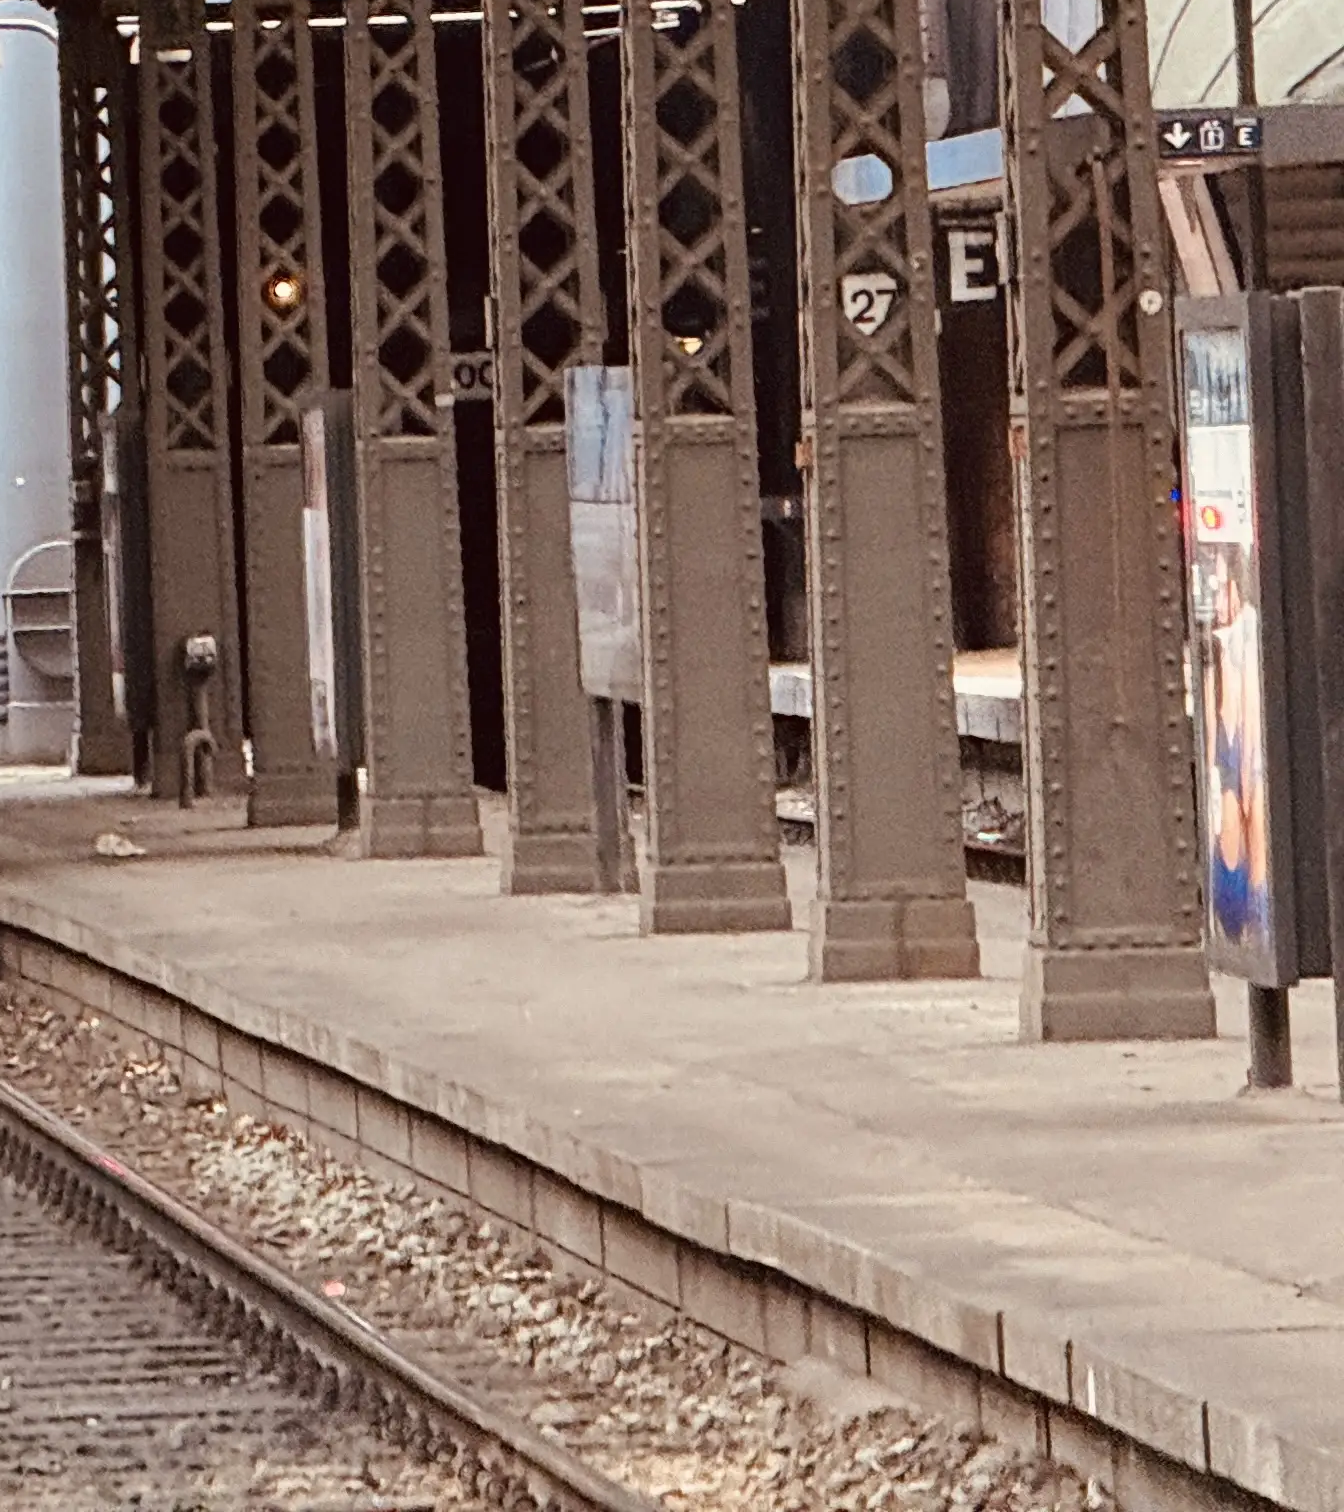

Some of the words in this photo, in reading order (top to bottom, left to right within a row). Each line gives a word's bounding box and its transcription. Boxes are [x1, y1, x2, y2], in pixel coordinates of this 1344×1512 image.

[1238, 127, 1253, 146] E
[948, 231, 998, 303] E
[850, 289, 896, 324] 27
